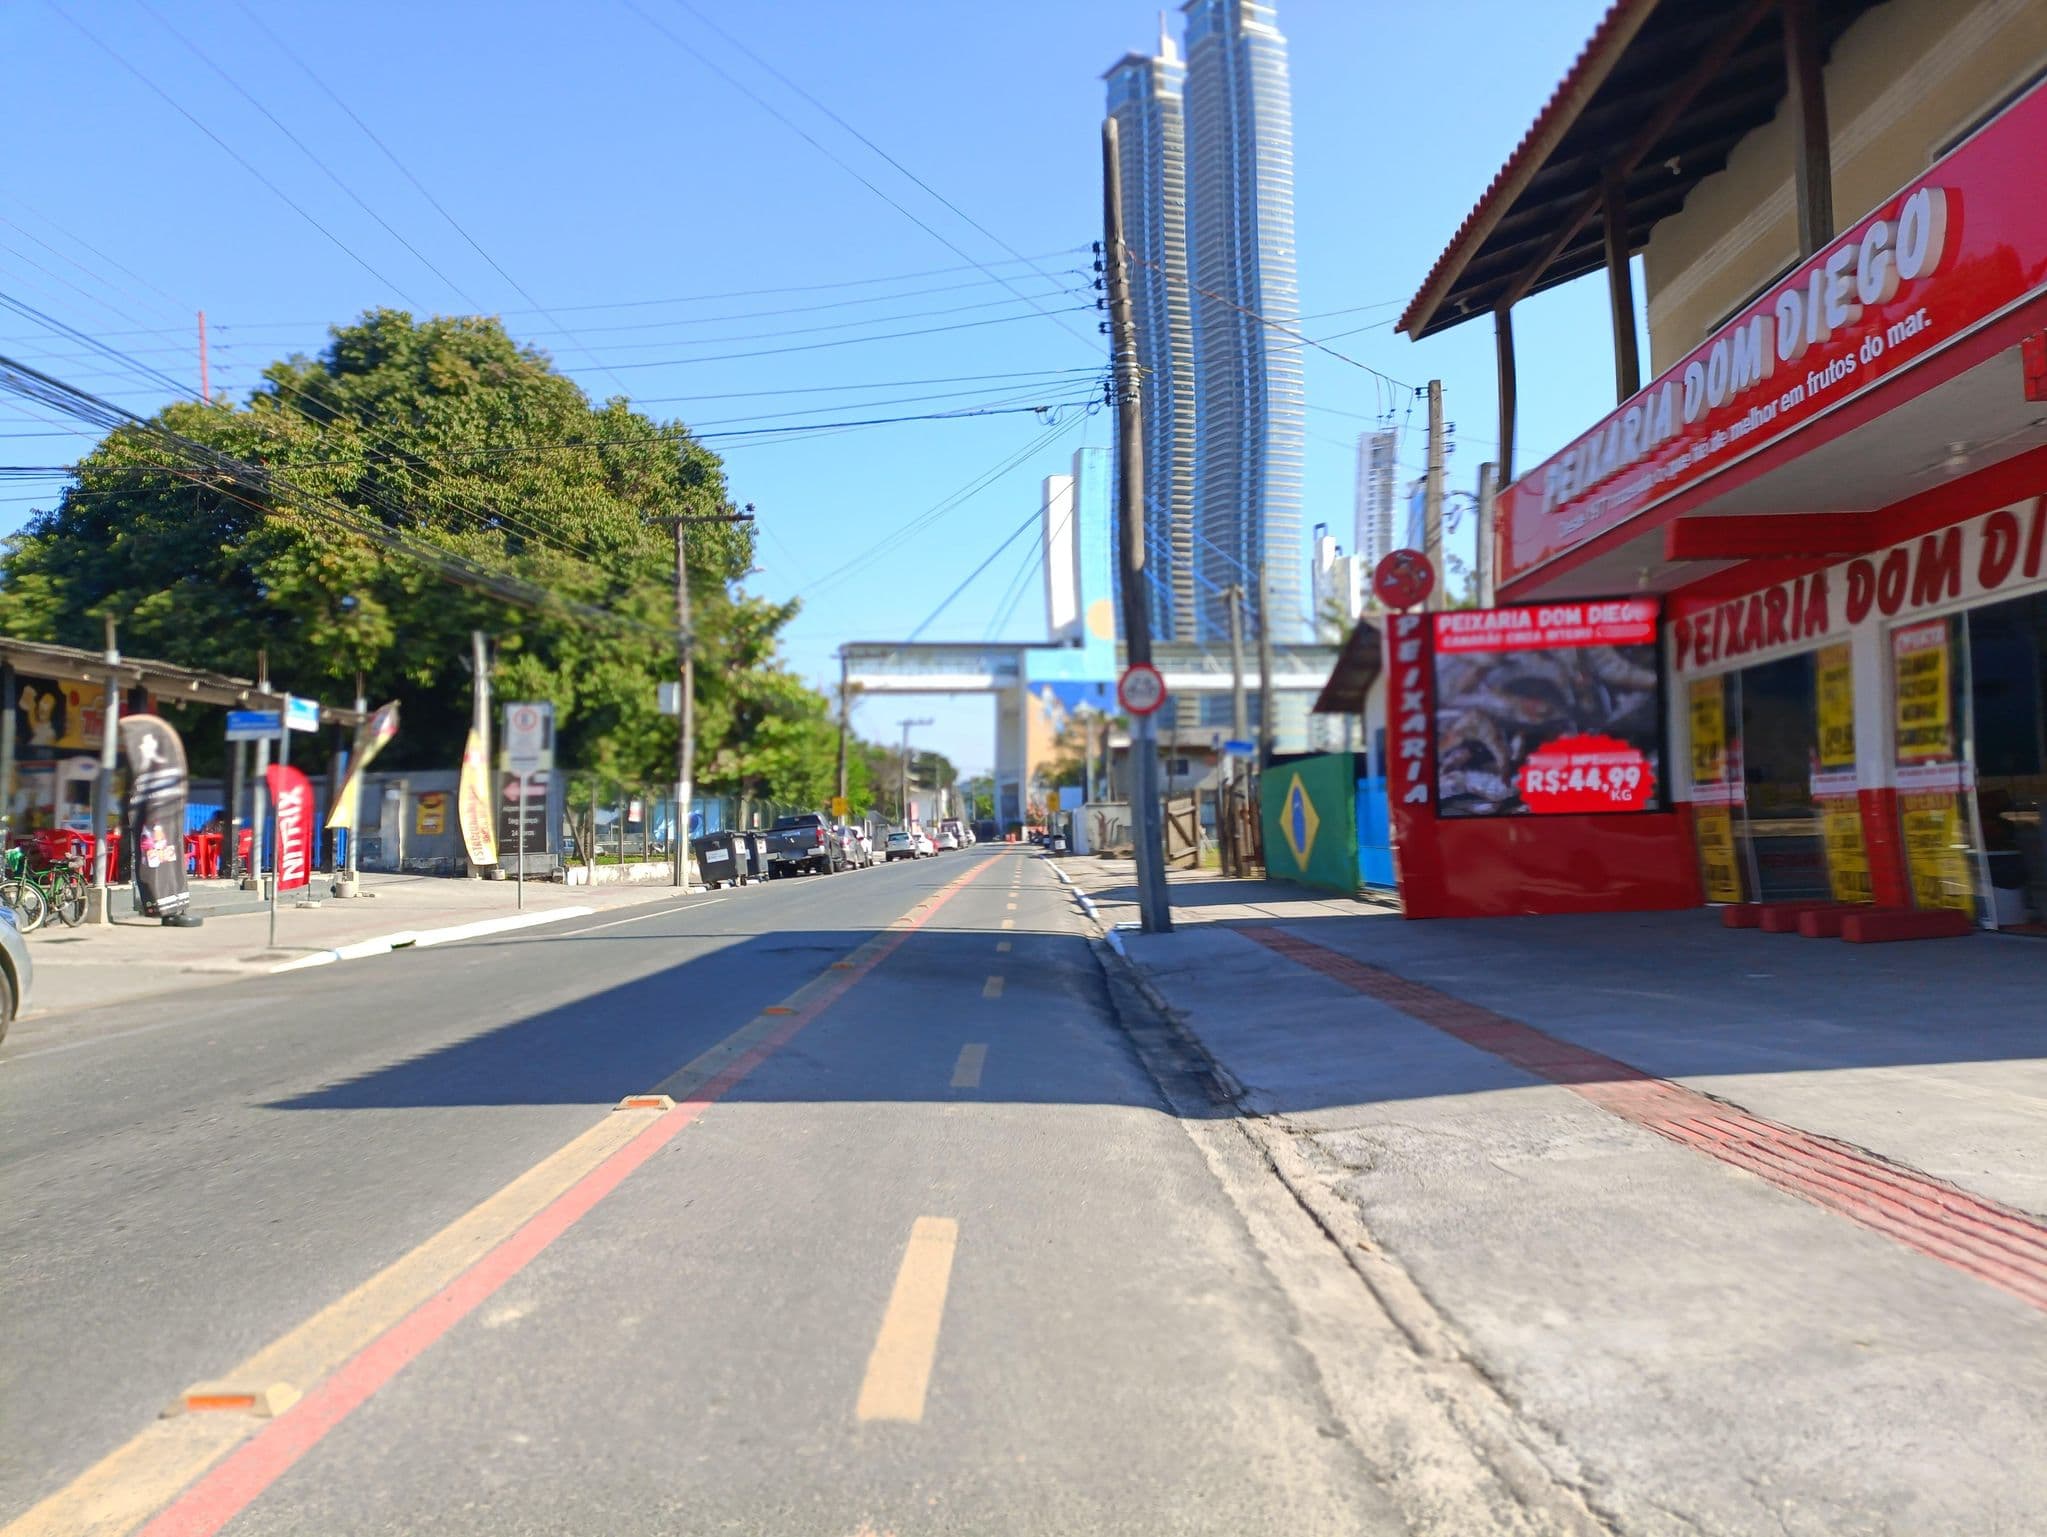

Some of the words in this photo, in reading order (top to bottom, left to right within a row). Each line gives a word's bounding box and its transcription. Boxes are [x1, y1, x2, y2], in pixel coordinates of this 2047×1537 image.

[1542, 381, 1675, 514] PEIXARIA
[1684, 315, 1766, 425] DOM
[1777, 187, 1938, 361] DIEGO
[1727, 399, 1778, 442] melhor
[1781, 383, 1804, 413] em
[1807, 353, 1857, 397] frutos
[1859, 334, 1884, 363] do
[1886, 307, 1933, 348] mar.
[1438, 610, 1532, 633] PEIXARIA
[1537, 606, 1582, 627] DOM
[1674, 572, 1830, 672] PEIXARIA
[1846, 526, 1964, 625] DOM
[1396, 614, 1428, 804] PEIXARIA
[278, 785, 305, 882] NITRIX
[1526, 766, 1641, 795] R$:44,99
